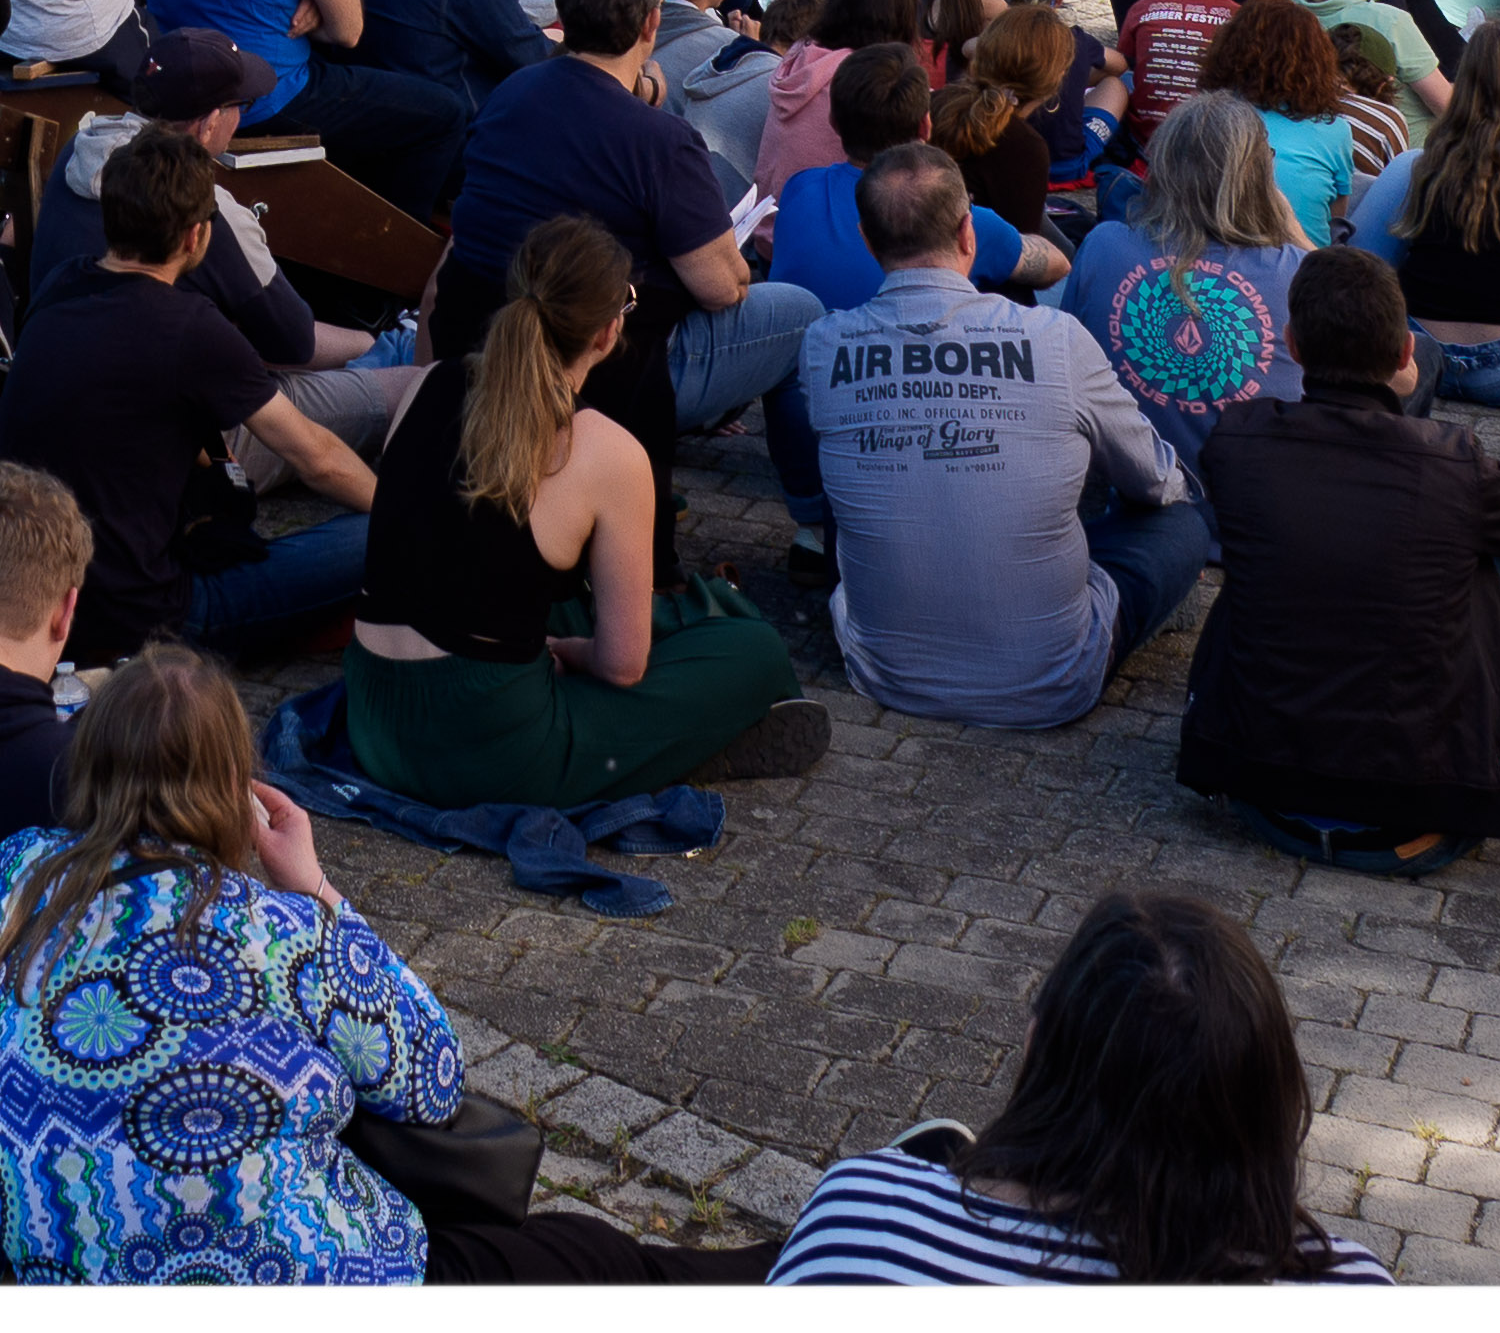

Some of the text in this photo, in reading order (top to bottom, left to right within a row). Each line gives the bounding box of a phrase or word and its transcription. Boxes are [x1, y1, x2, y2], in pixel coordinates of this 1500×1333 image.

[1140, 11, 1228, 25] SUMMER FESTIV
[1109, 255, 1275, 374] VOLCOM STNE COMPANY
[829, 339, 1036, 389] AIR BORN
[855, 380, 1001, 404] FLYING SQUAD DEPT.
[1119, 359, 1169, 407] TRUE
[1176, 399, 1207, 414] TO
[924, 407, 975, 420] OFFICIAL
[980, 408, 1026, 421] DEVICES
[852, 419, 996, 454] Wings of Glory
